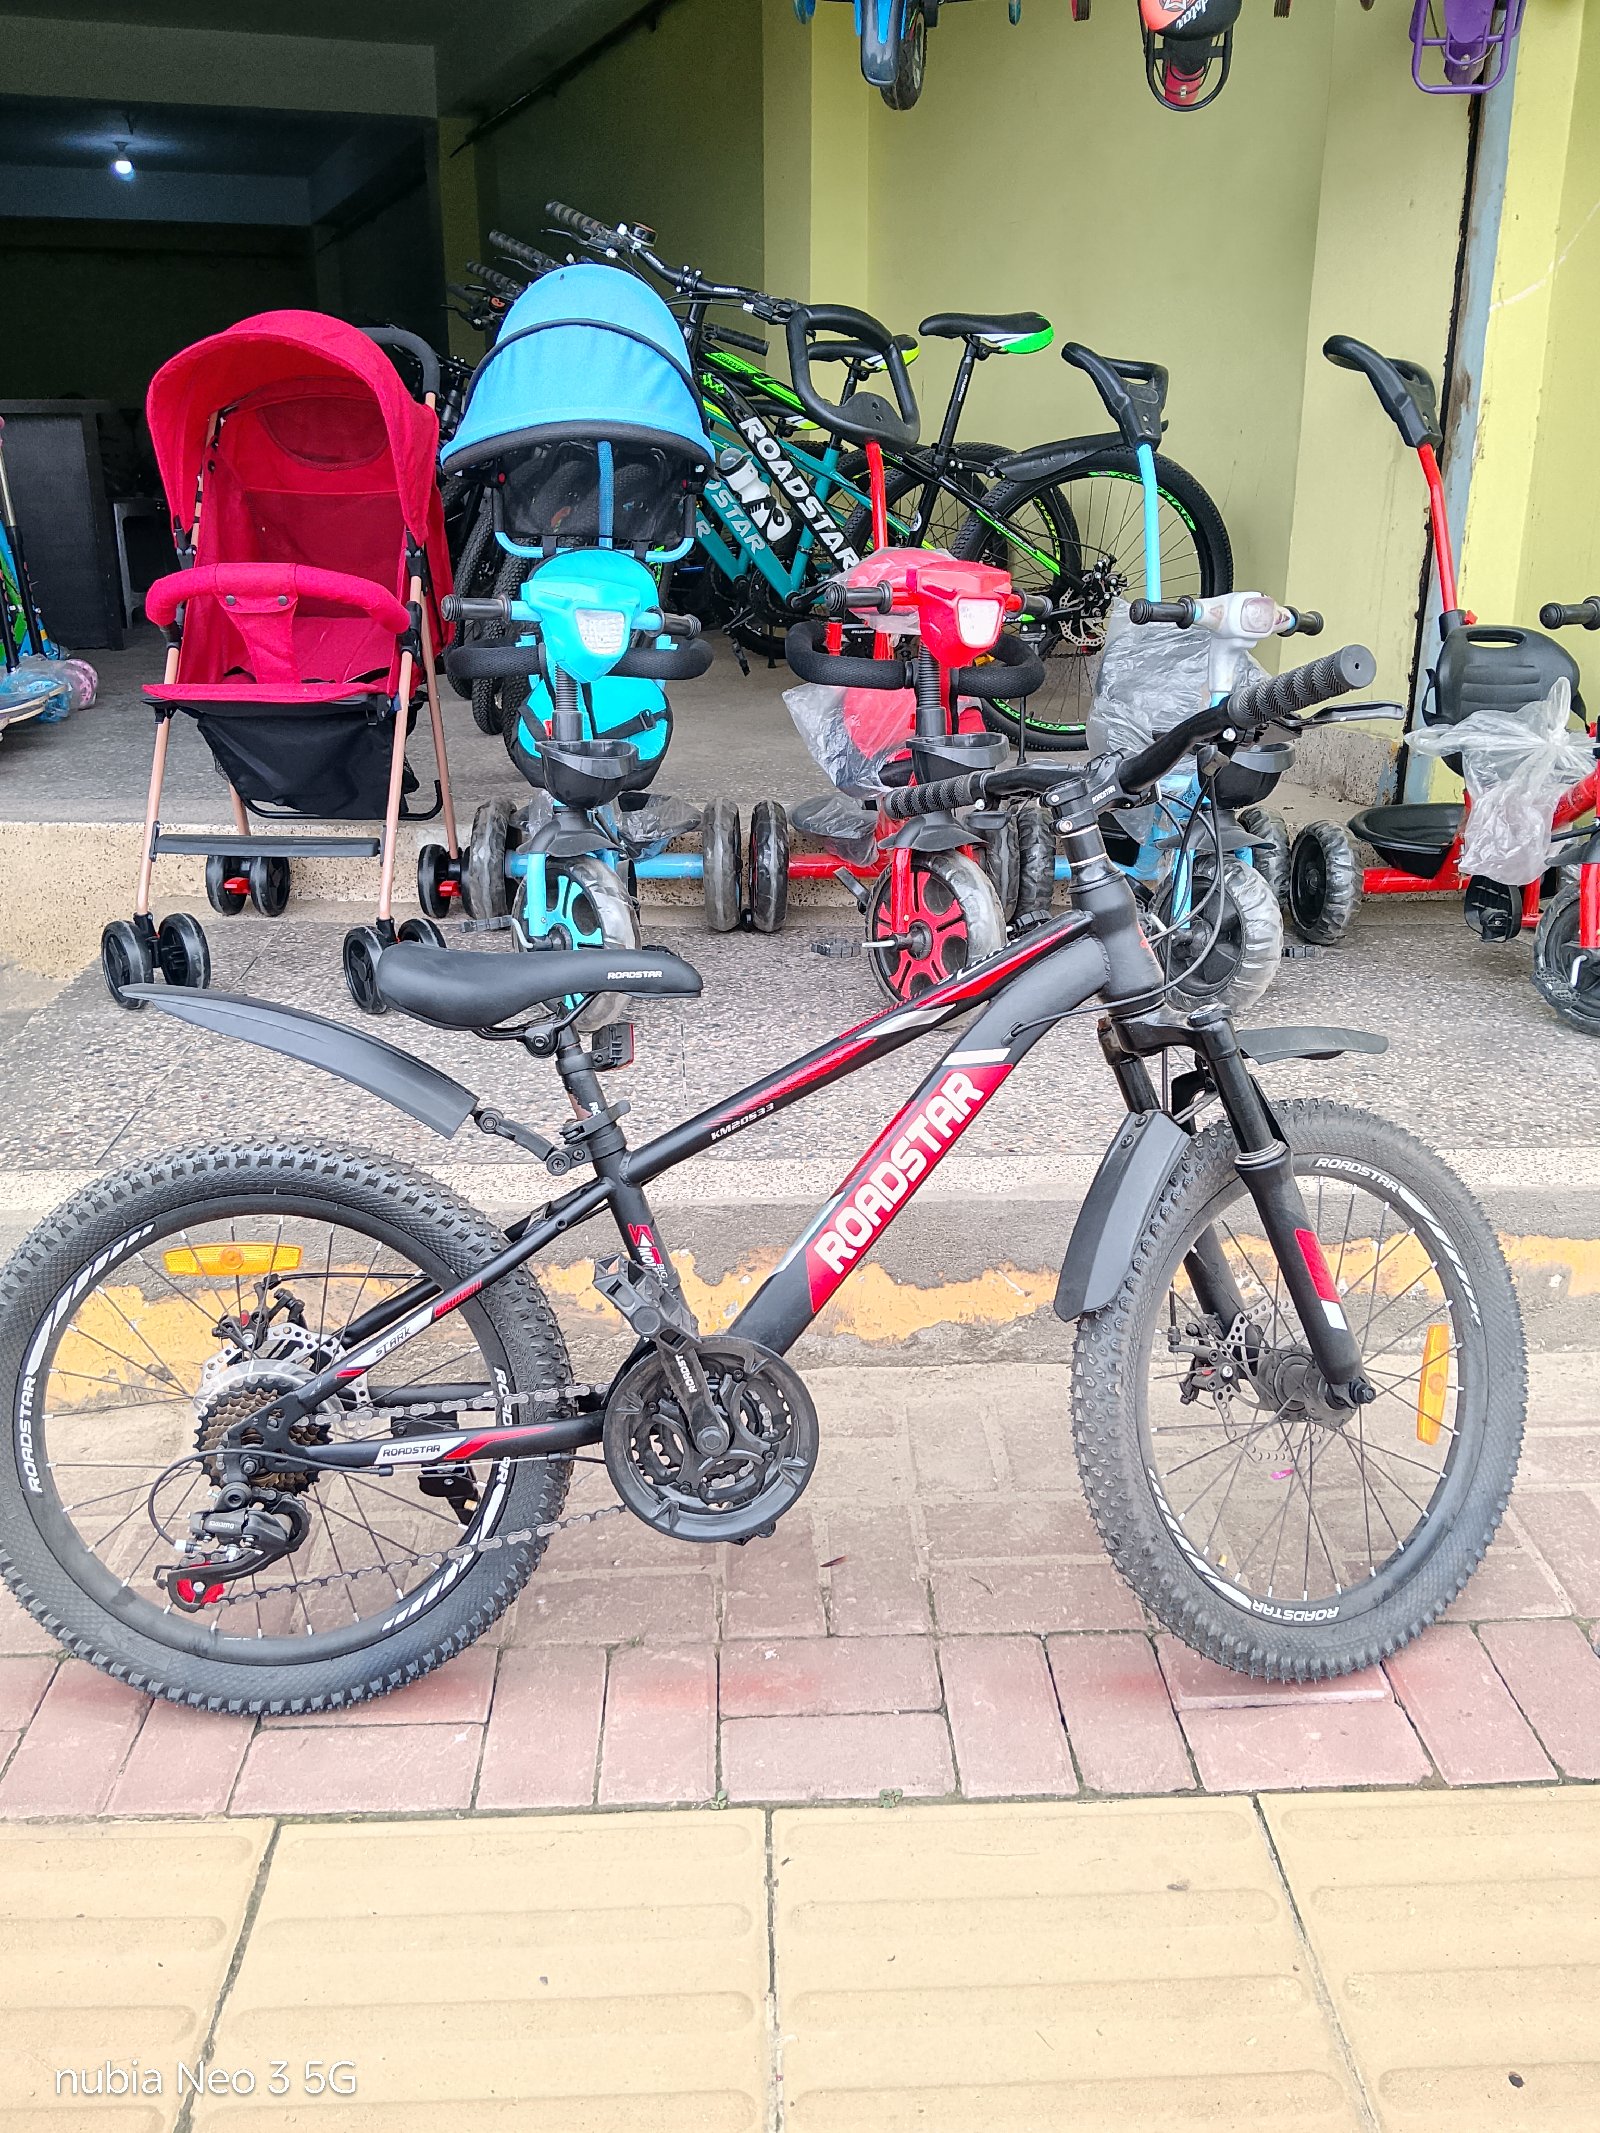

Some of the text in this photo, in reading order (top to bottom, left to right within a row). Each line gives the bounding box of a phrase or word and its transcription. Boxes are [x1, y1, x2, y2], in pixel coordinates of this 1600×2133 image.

[739, 416, 861, 572] ROADSTAR
[607, 970, 663, 980] ROADSTAR
[813, 1072, 985, 1275] ROADSTAR
[1315, 1157, 1400, 1194] ROADSTAR
[375, 1326, 412, 1358] STARK
[19, 1374, 44, 1493] ROADSTAR
[382, 1444, 441, 1457] ROADSTAR
[1252, 1598, 1340, 1622] ROADSTAR
